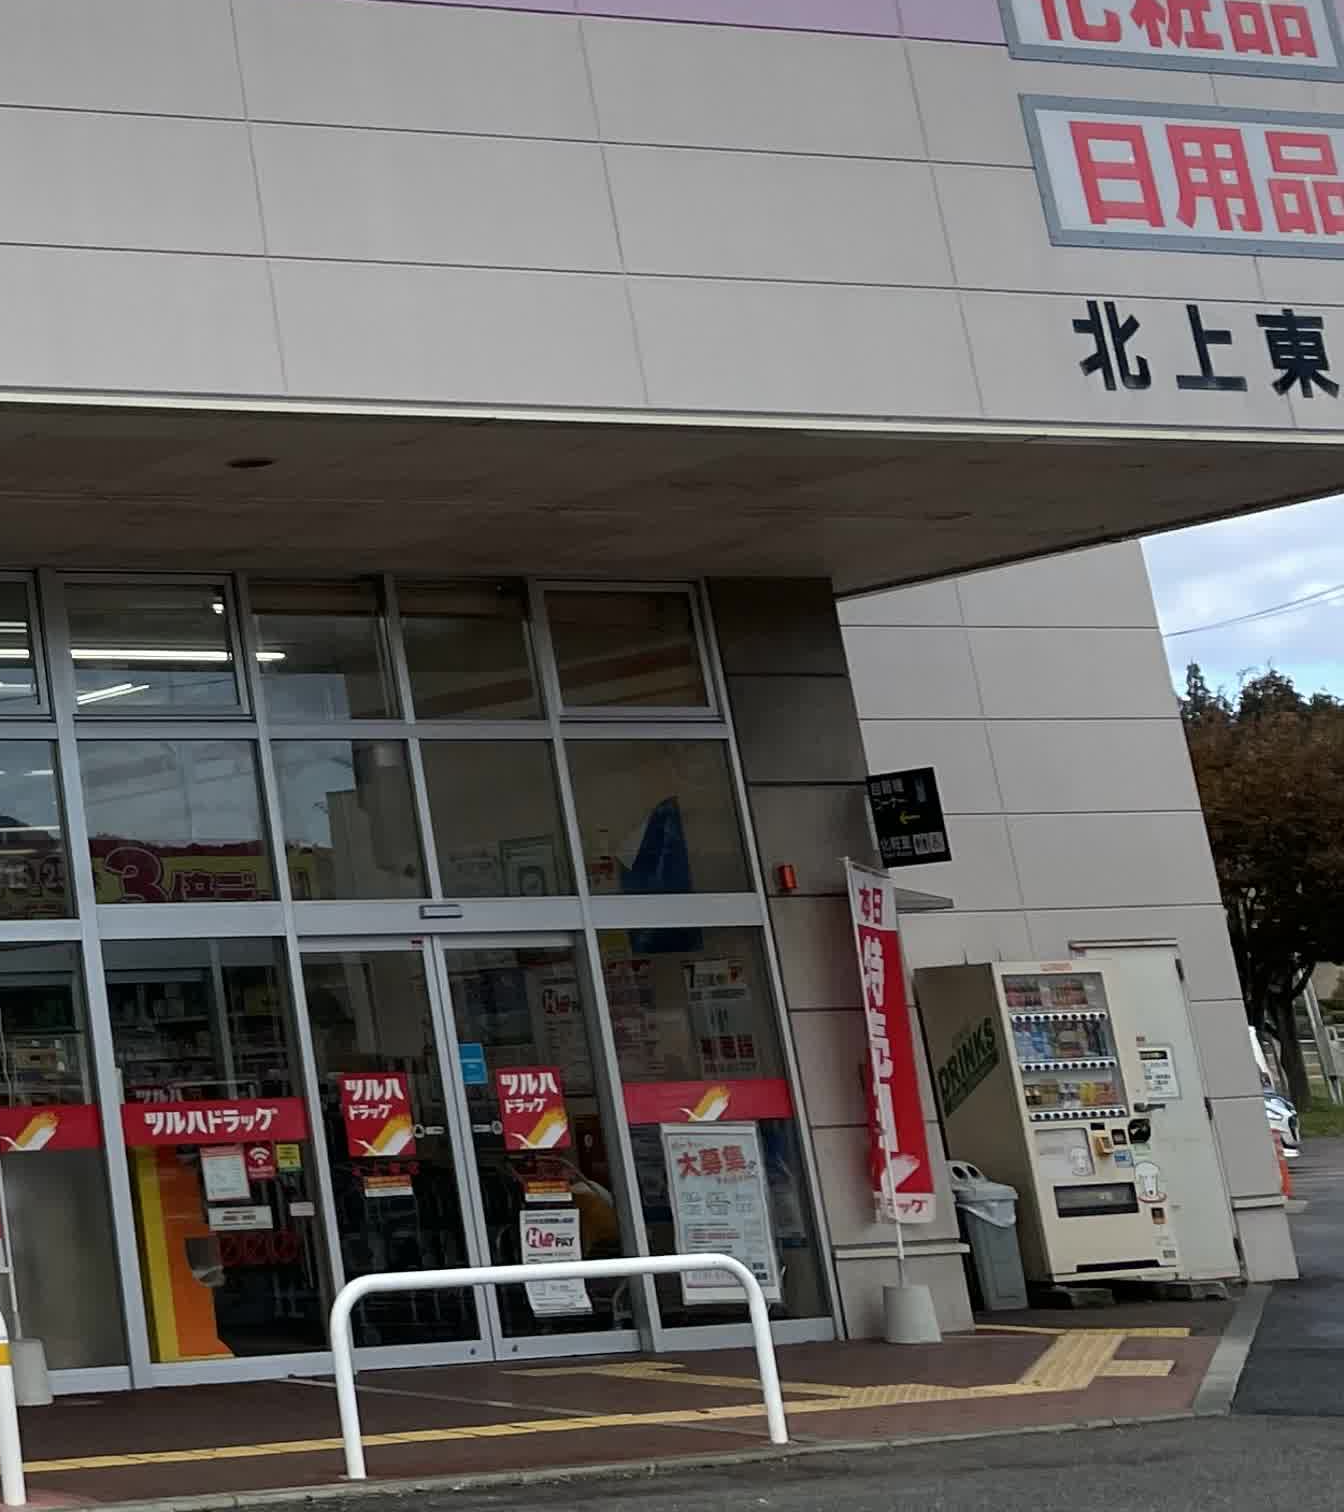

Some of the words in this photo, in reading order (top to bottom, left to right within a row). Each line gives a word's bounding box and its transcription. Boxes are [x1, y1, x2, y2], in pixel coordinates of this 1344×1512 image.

[1069, 121, 1344, 235] 日用品
[1072, 300, 1341, 398] 北上東
[344, 1078, 405, 1101] ツルハ
[500, 1072, 559, 1095] ツルハ
[144, 1107, 279, 1136] ツルハドラッグ
